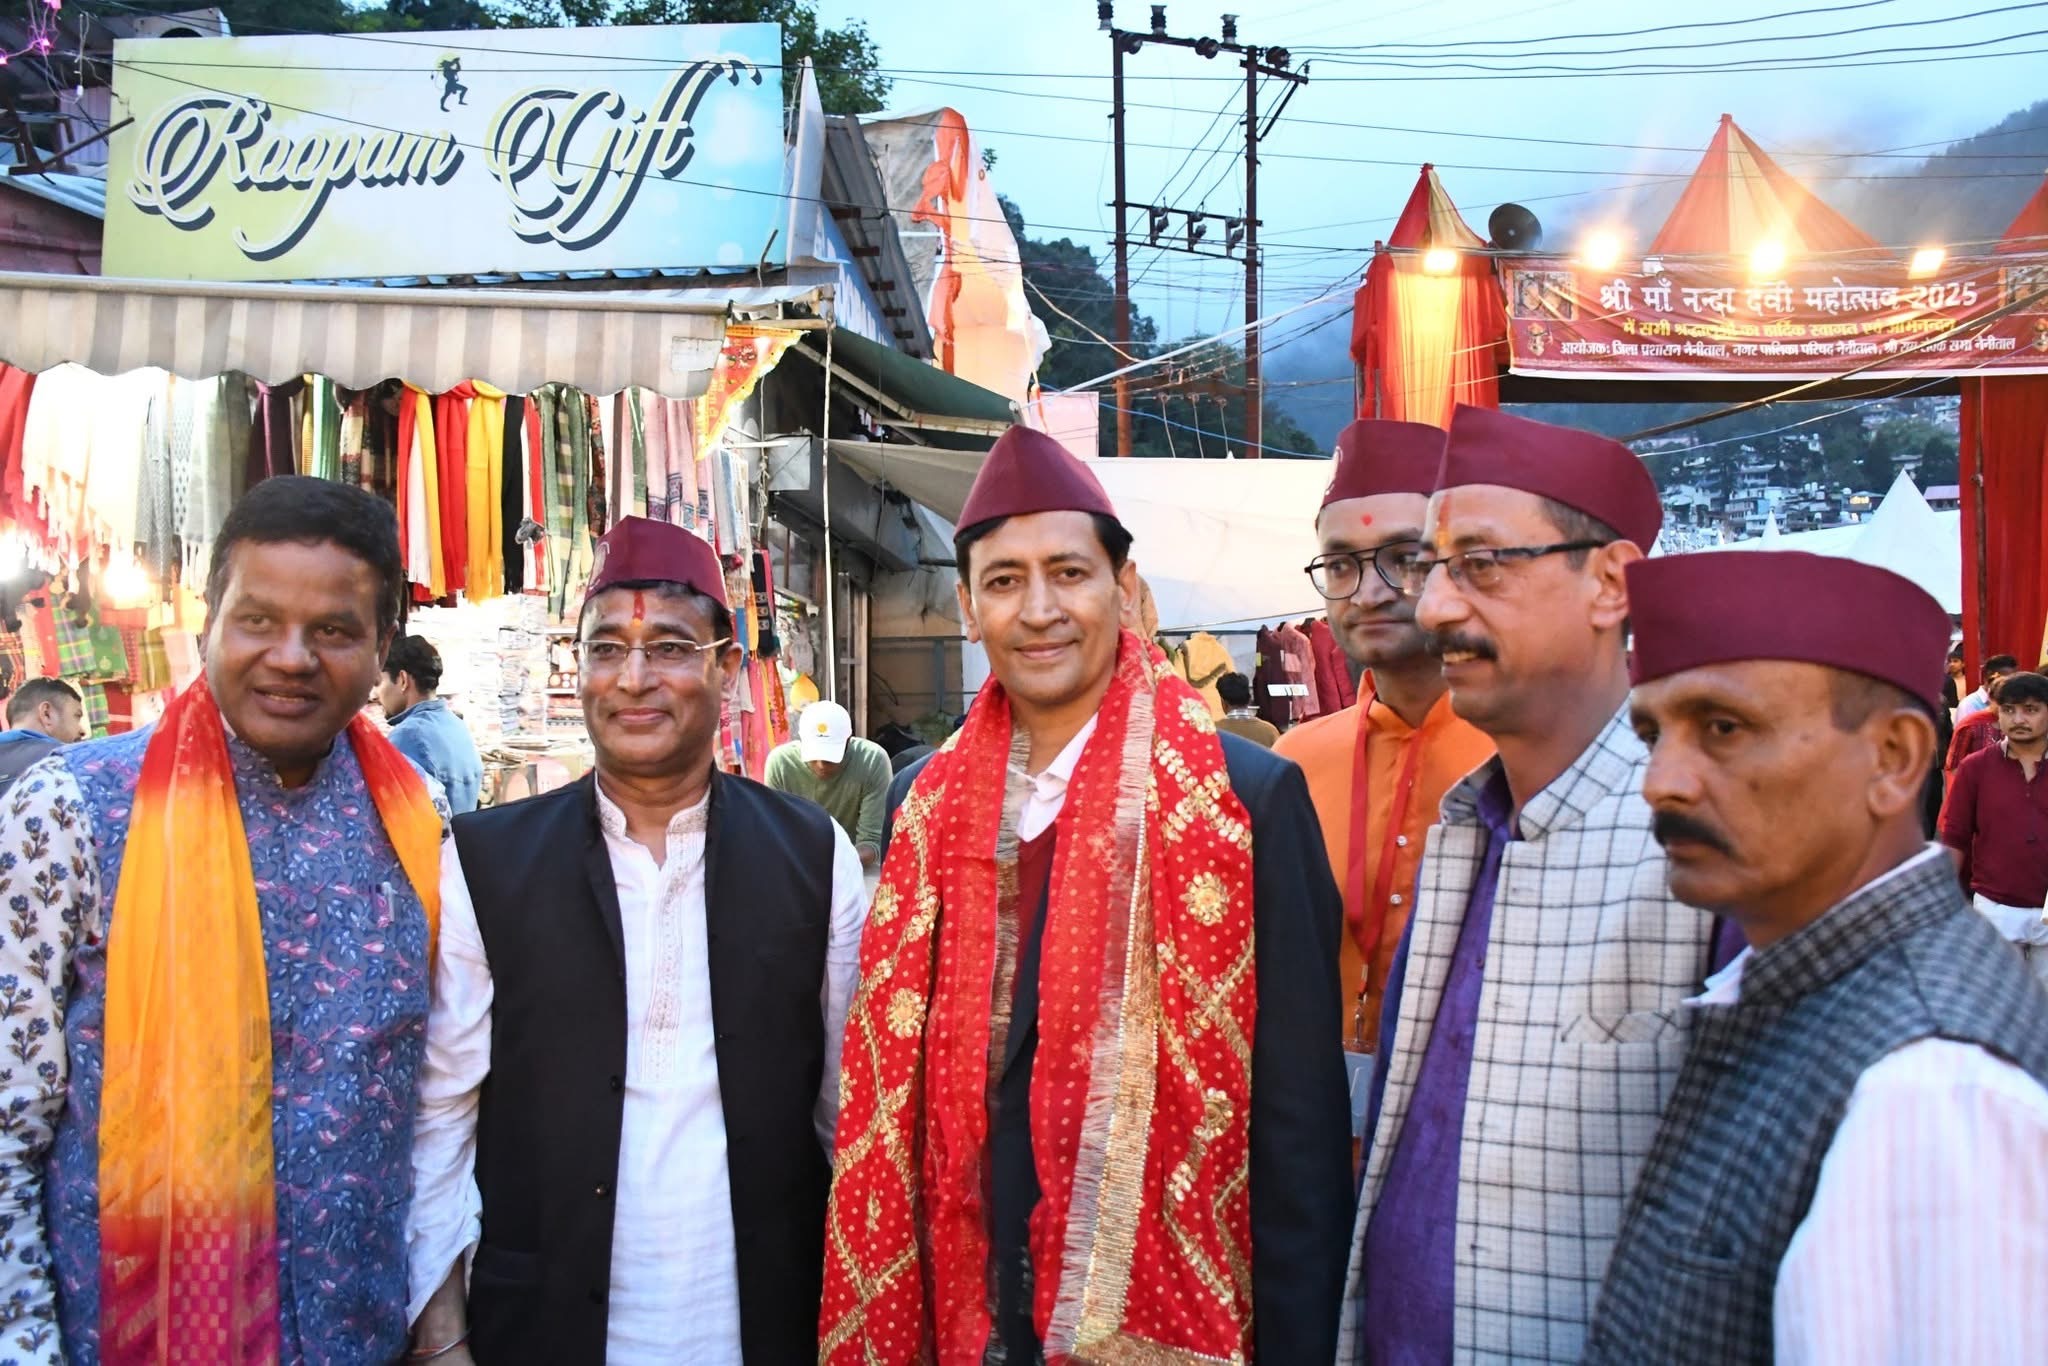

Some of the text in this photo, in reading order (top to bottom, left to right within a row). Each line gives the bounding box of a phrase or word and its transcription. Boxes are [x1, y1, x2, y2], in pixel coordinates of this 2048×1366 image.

[126, 53, 762, 262] Roopam Gift
[1600, 278, 1634, 312] श्री
[1640, 277, 1673, 312] माँ
[1681, 286, 1736, 317] नन्दा
[1803, 276, 1900, 315] महोत्सव
[1911, 281, 1978, 310] 2025
[1622, 317, 1636, 335] में
[1612, 340, 1638, 355] जिला
[1732, 343, 1758, 356] नगर
